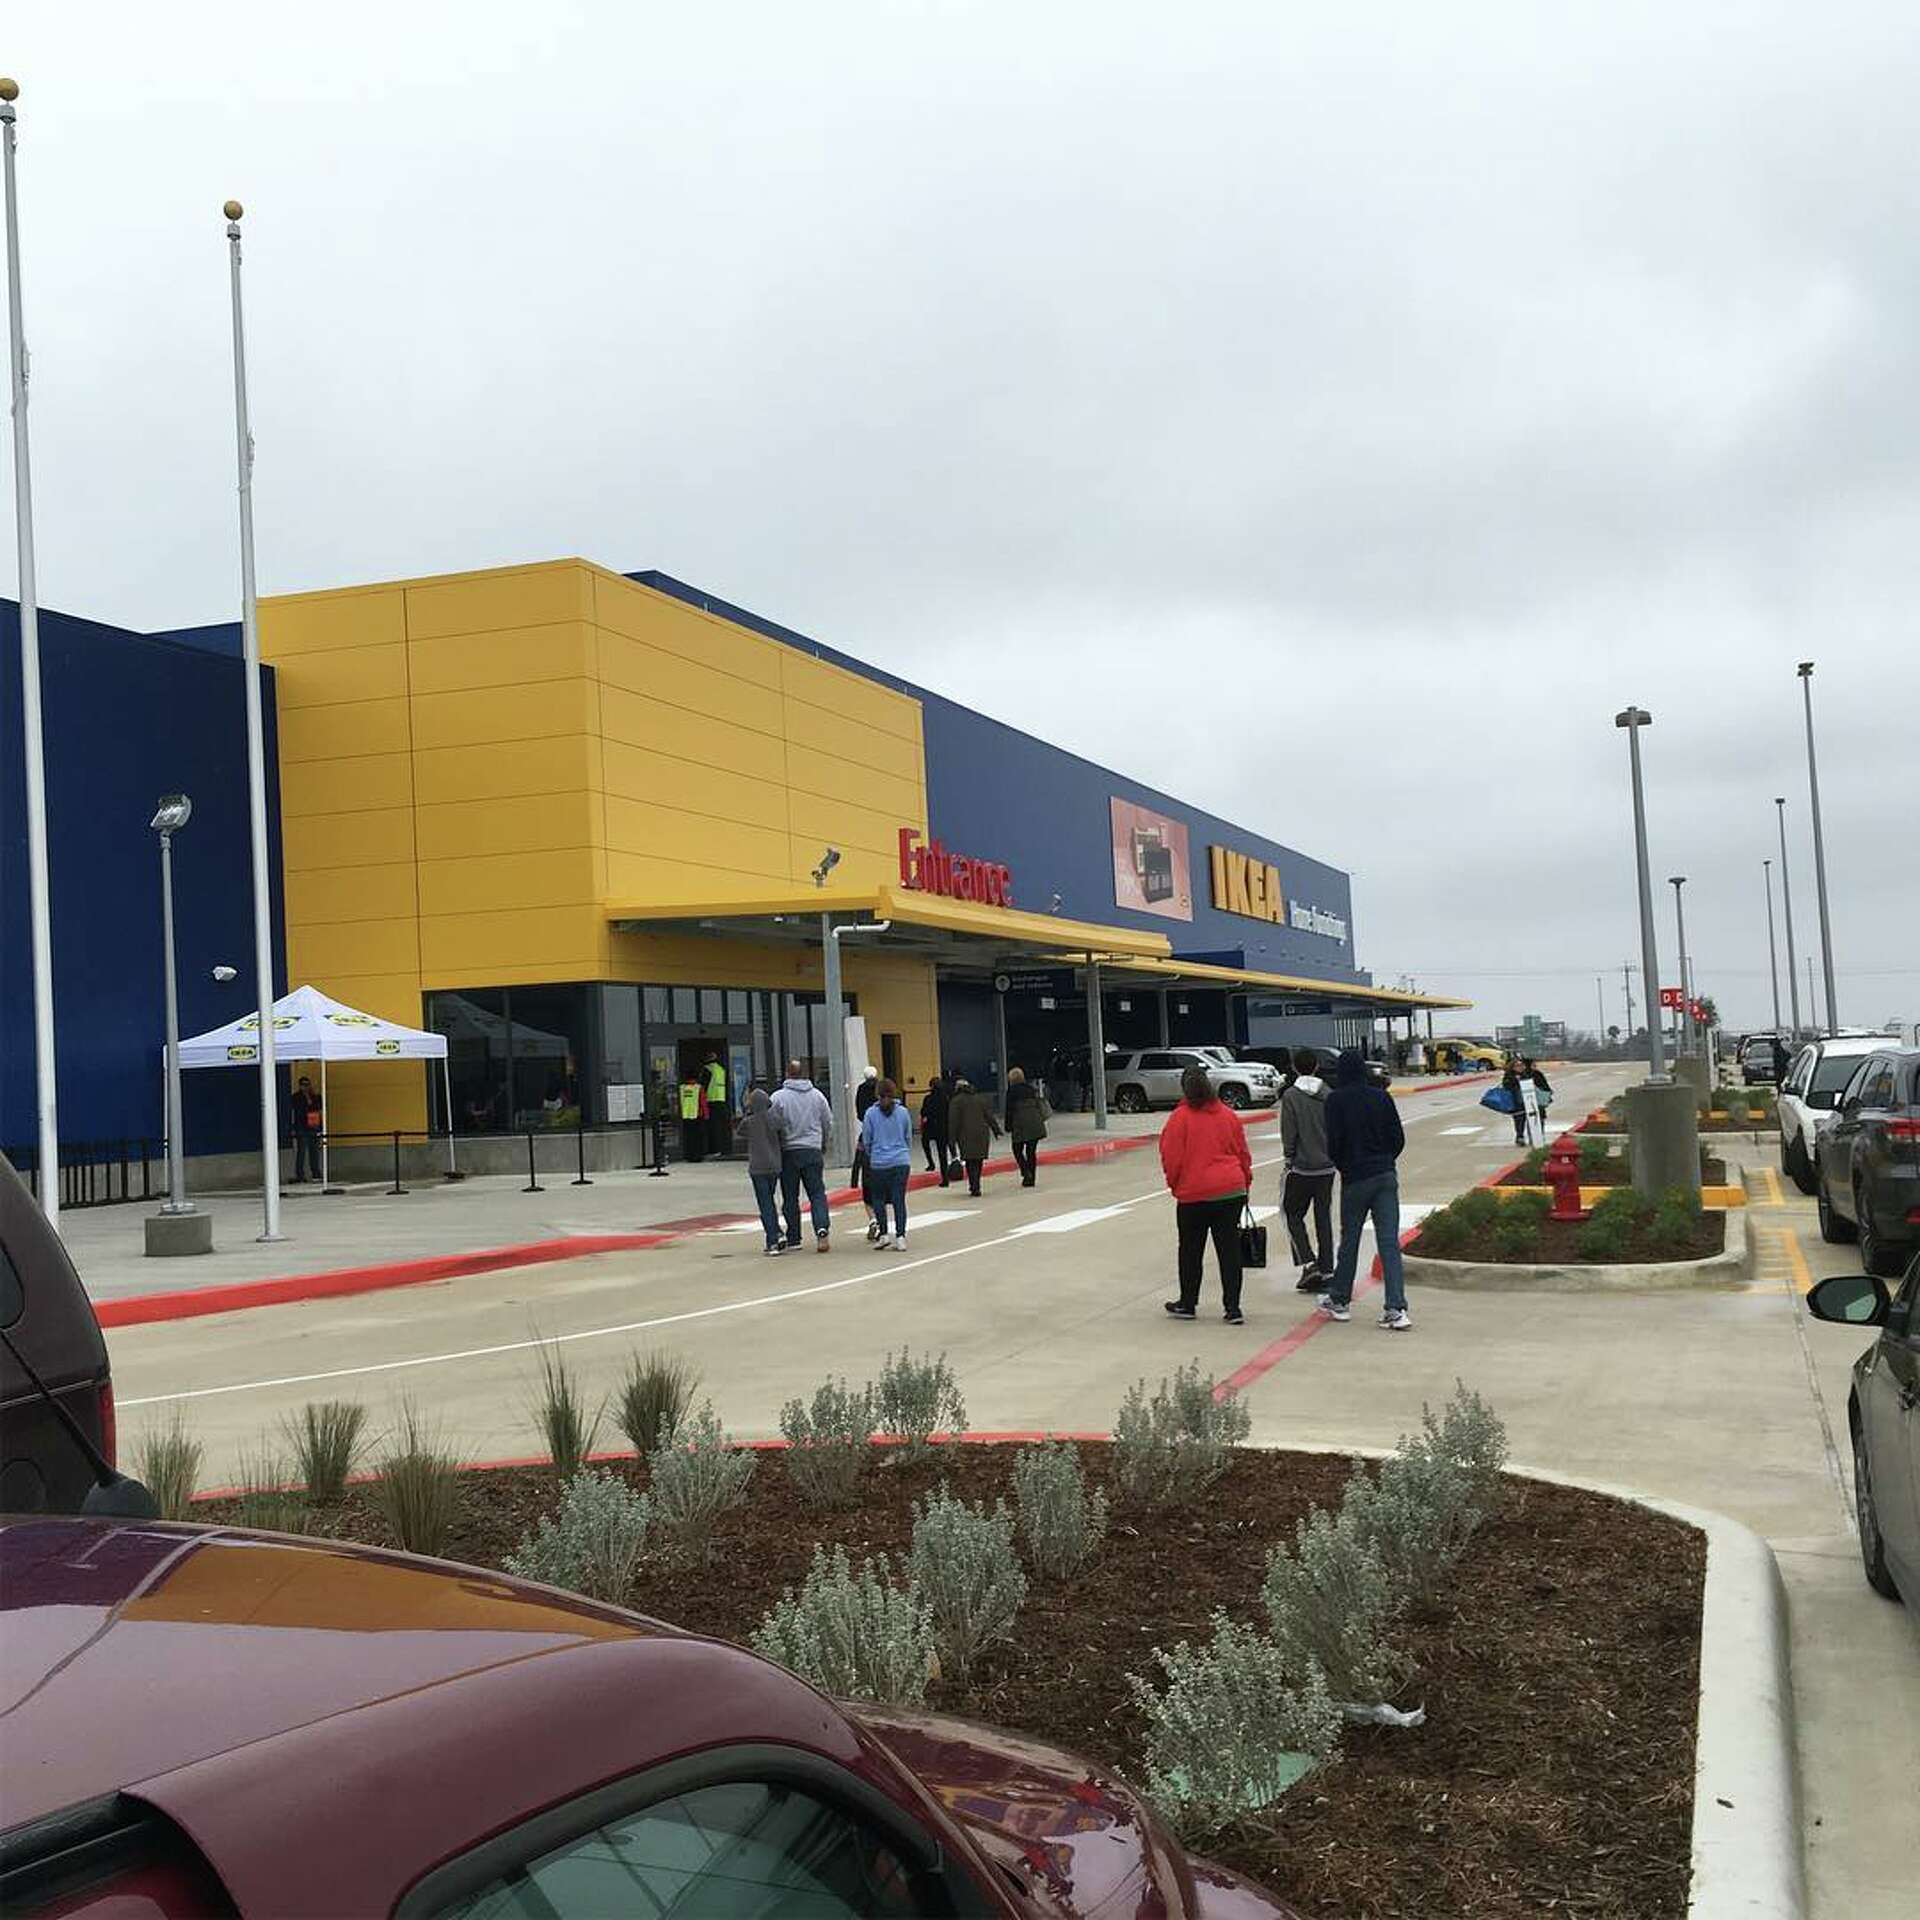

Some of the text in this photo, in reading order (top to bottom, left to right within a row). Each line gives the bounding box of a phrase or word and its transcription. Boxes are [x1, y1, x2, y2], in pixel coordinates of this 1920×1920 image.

[898, 828, 1016, 907] Entrance
[1208, 845, 1285, 926] IKEA
[1663, 993, 1672, 1003] D
